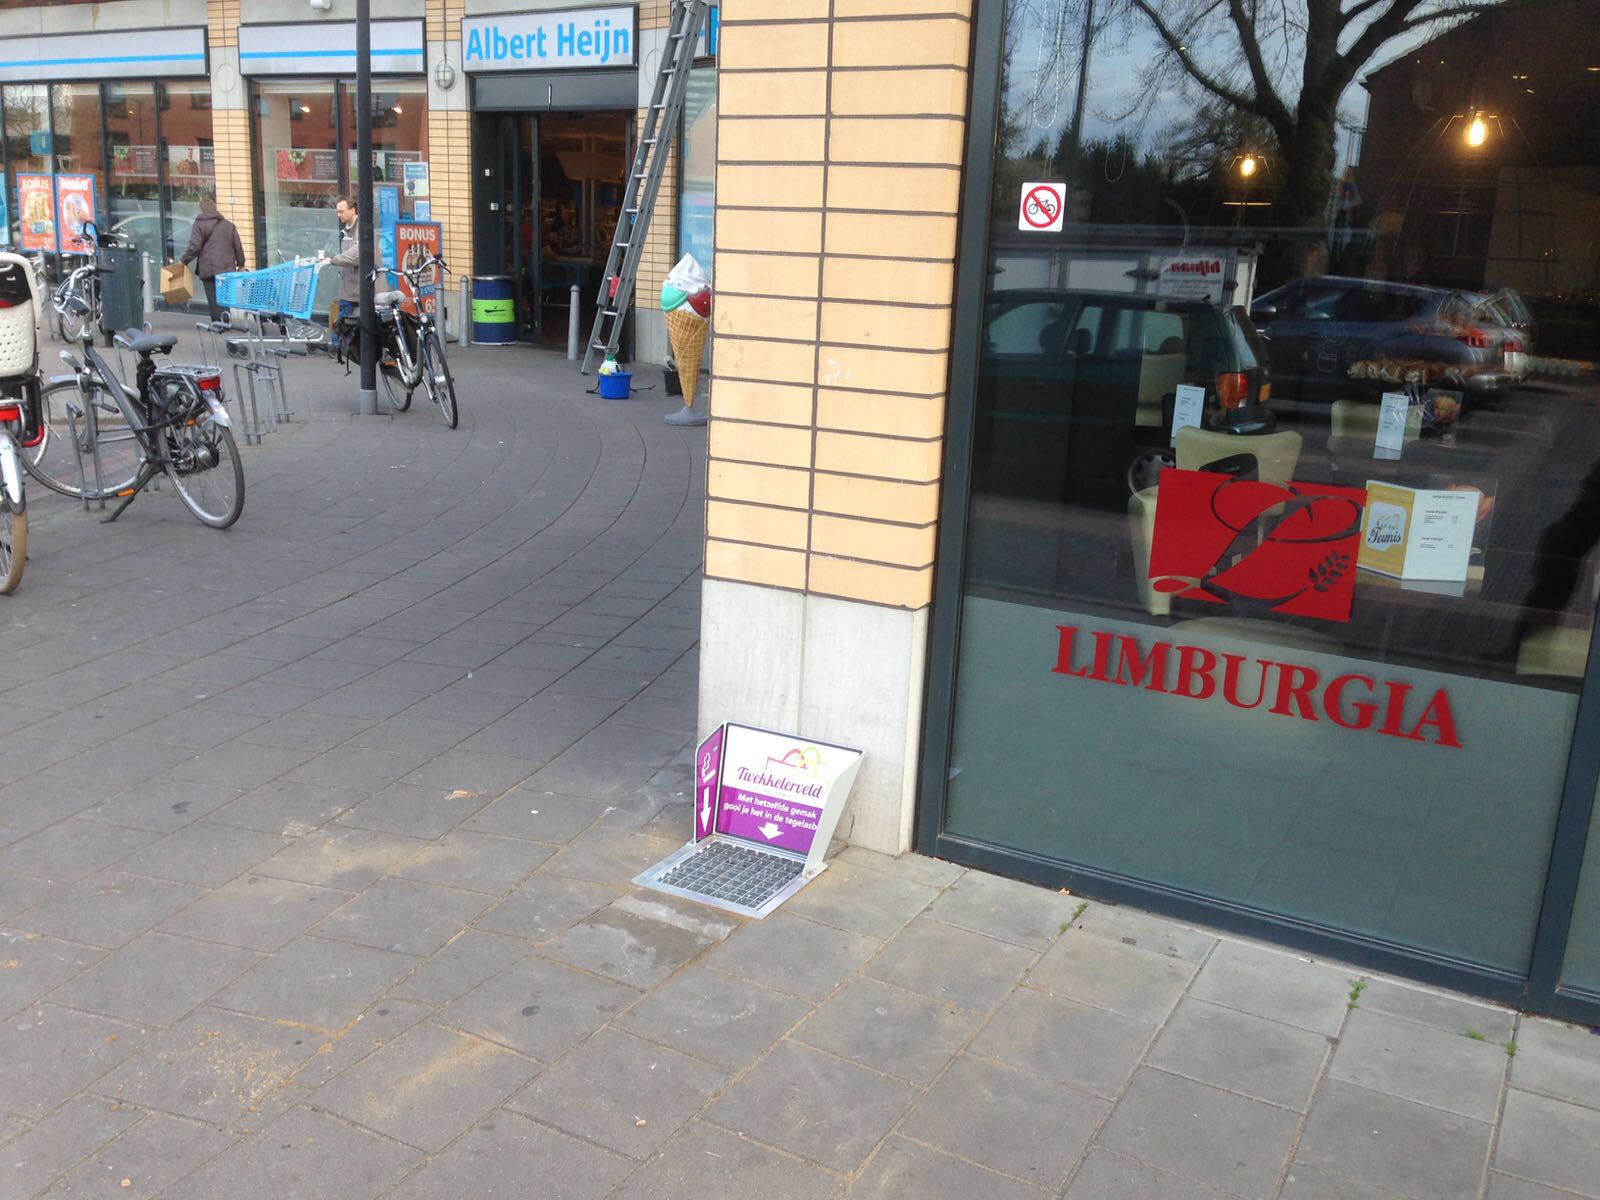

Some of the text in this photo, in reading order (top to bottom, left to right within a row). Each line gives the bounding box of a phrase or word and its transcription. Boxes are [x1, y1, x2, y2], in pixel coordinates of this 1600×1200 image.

[466, 19, 629, 64] Albert Heijn
[22, 179, 49, 189] BONUS
[399, 227, 436, 241] BONUS
[1051, 624, 1463, 748] LIMBURGIA
[737, 766, 823, 798] Twekkelerveld
[723, 802, 819, 830] gooi je het in de tegelasb
[737, 793, 754, 803] Met
[754, 796, 789, 812] hetzelfde
[790, 807, 817, 819] gemak
